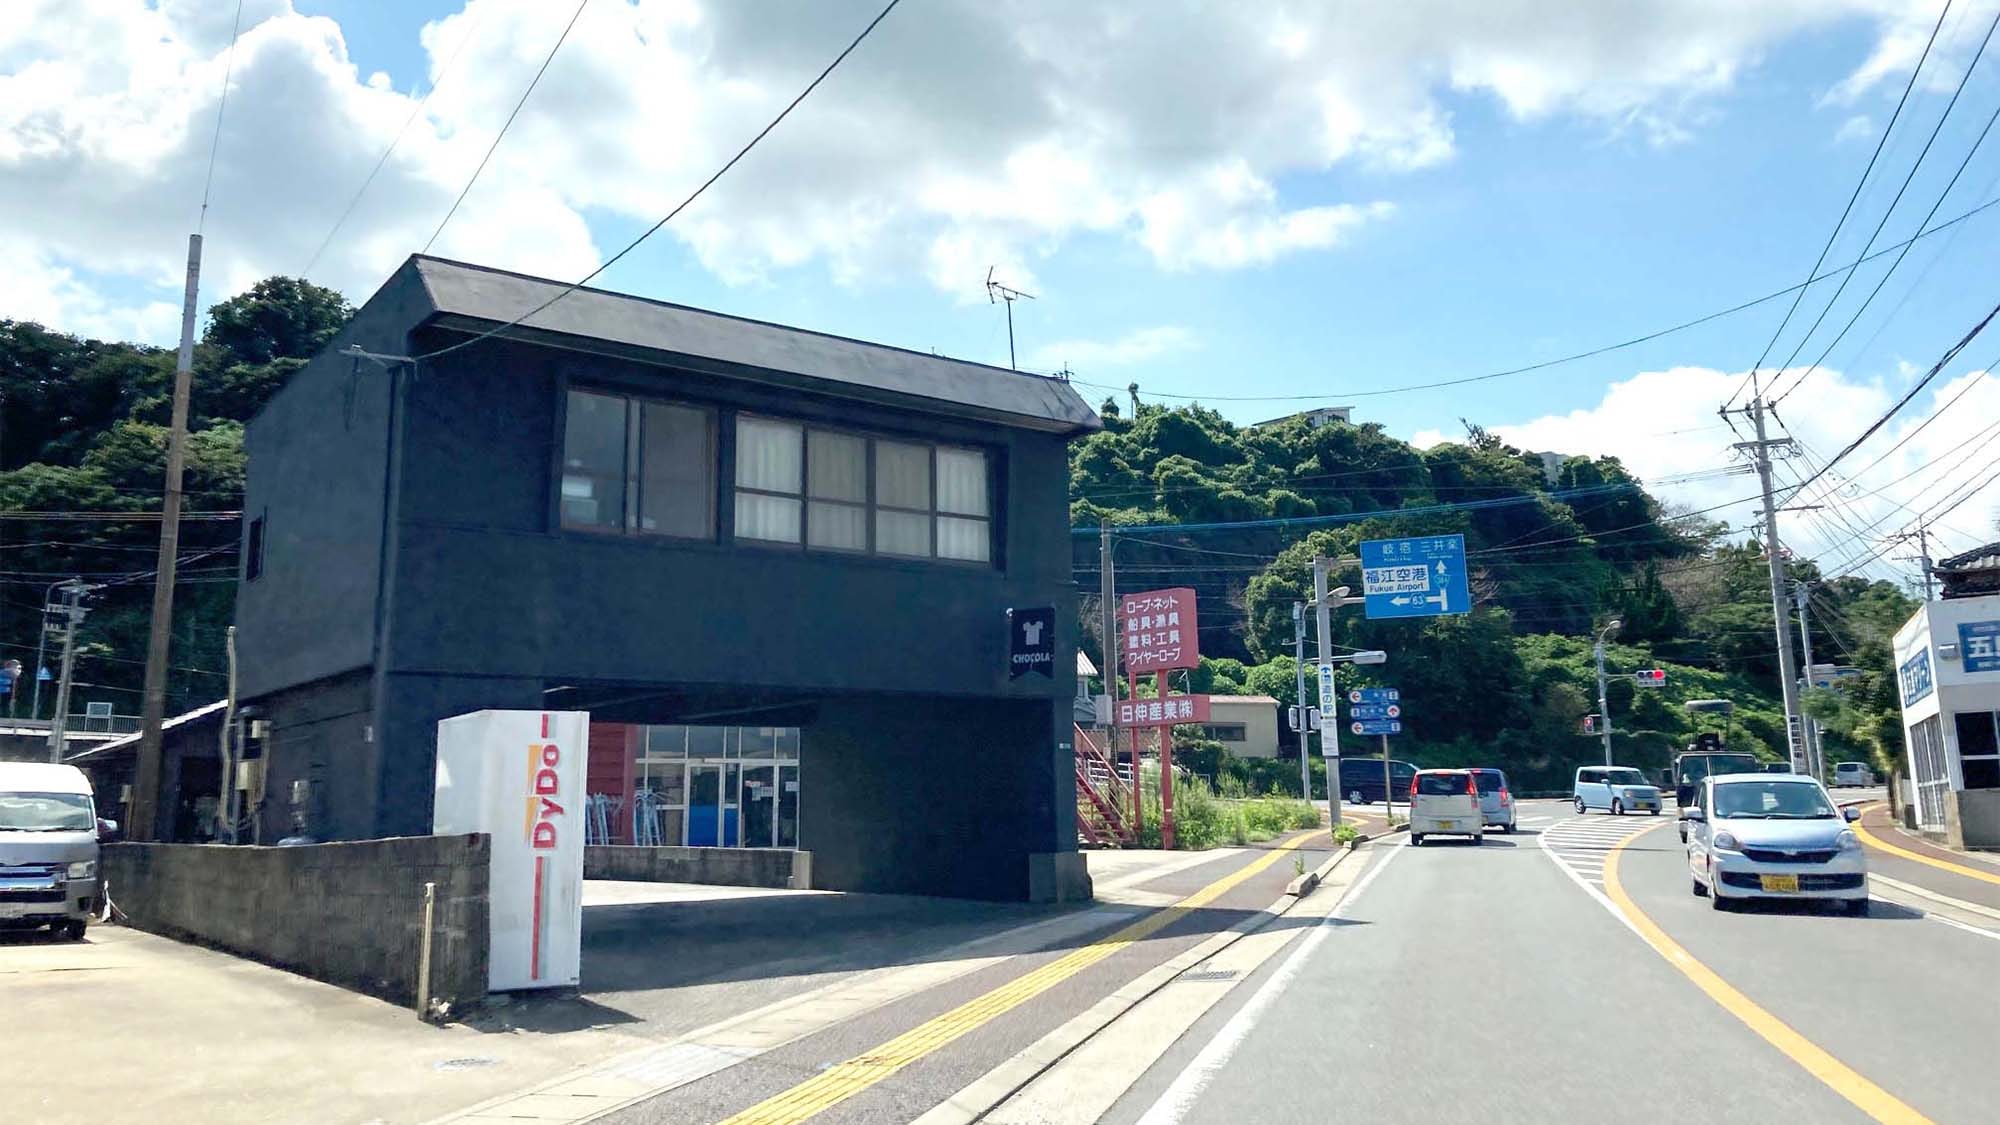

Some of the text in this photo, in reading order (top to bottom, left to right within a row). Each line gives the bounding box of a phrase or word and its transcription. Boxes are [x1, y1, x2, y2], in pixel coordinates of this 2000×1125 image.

[1366, 567, 1427, 584] 福江空港
[1397, 582, 1424, 591] Airport
[1412, 595, 1424, 605] 63
[1013, 652, 1050, 664] CHOCOLA
[533, 744, 564, 848] DyDo
